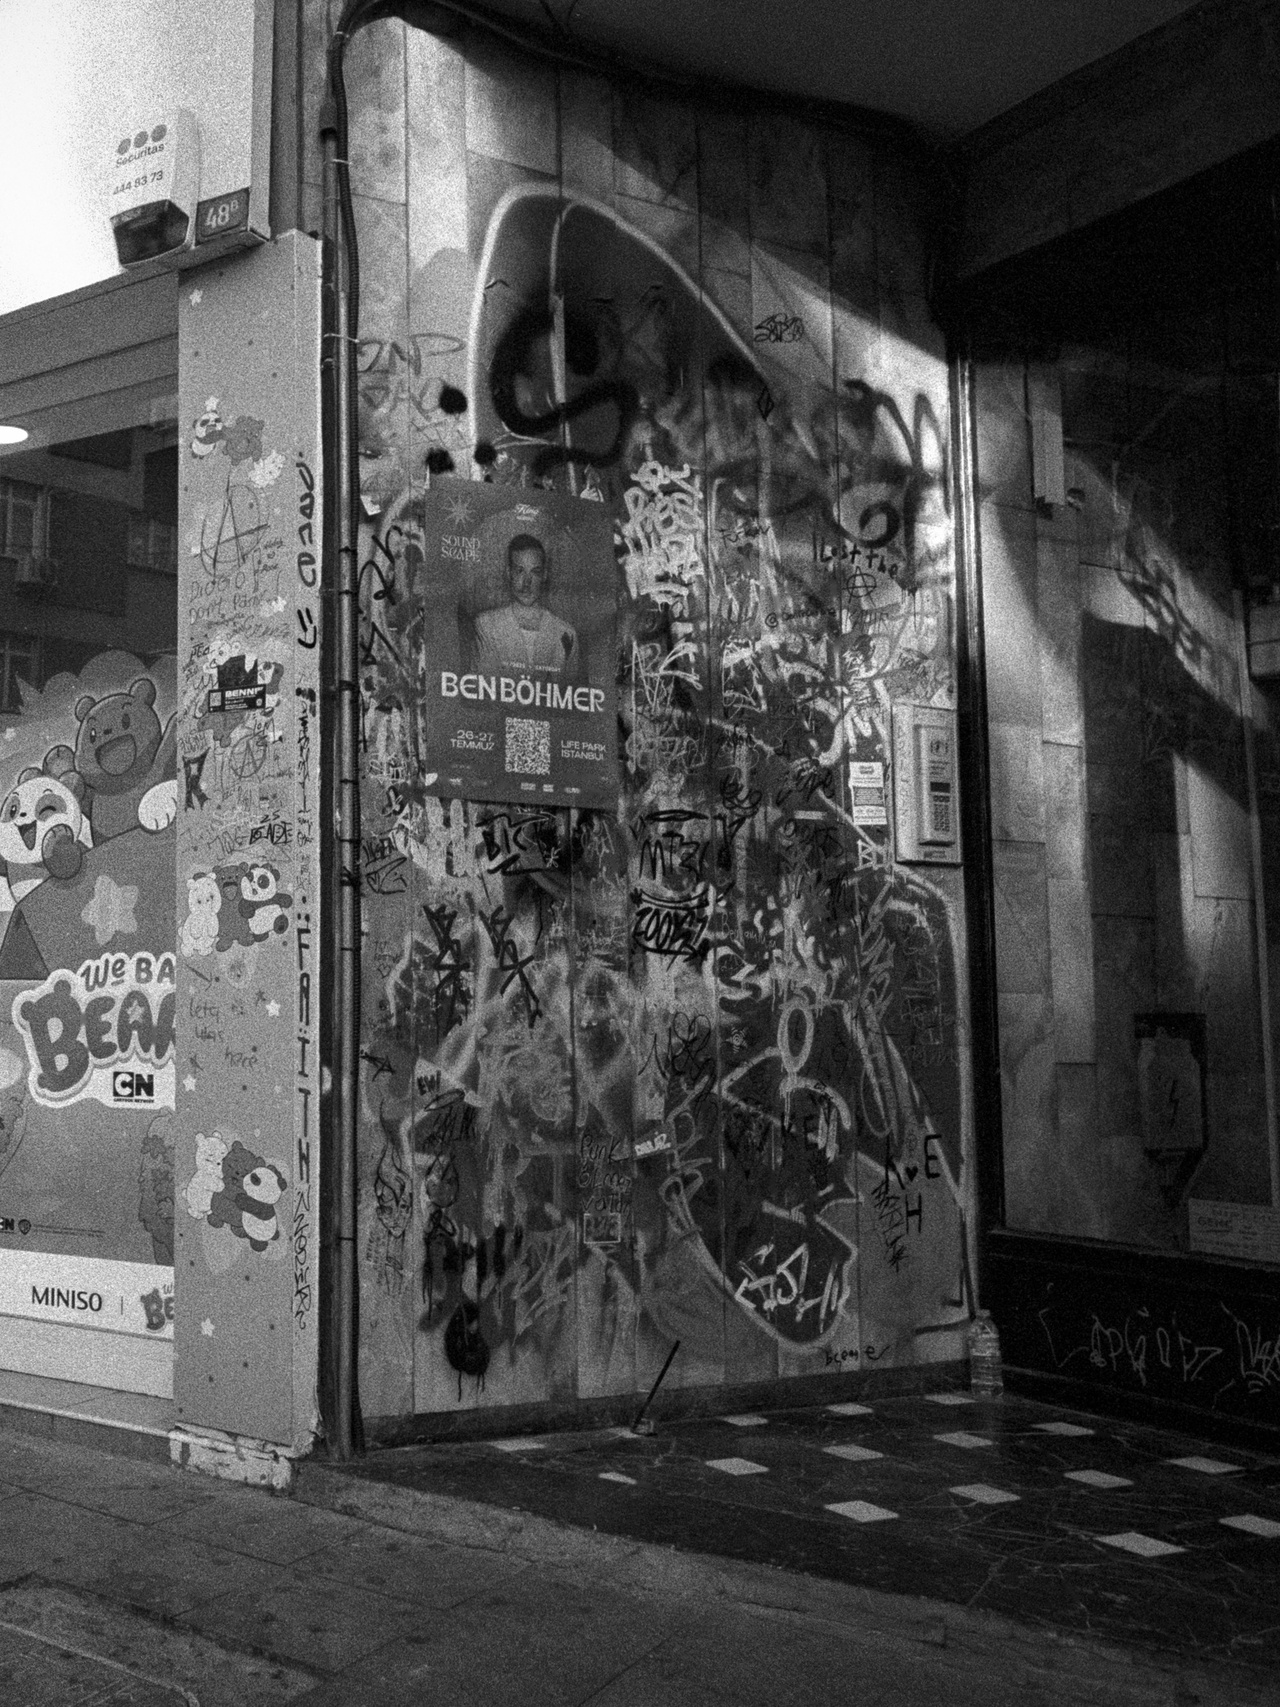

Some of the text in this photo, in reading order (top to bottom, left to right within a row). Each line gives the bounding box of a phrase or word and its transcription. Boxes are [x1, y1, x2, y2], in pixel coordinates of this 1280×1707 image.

[115, 143, 164, 168] Securitas
[441, 671, 605, 712] BEN BÖHMER
[450, 738, 495, 750] TEMMUZ
[561, 740, 607, 752] LIFE PARK
[113, 1071, 154, 1097] CN
[31, 1285, 102, 1312] MINISO
